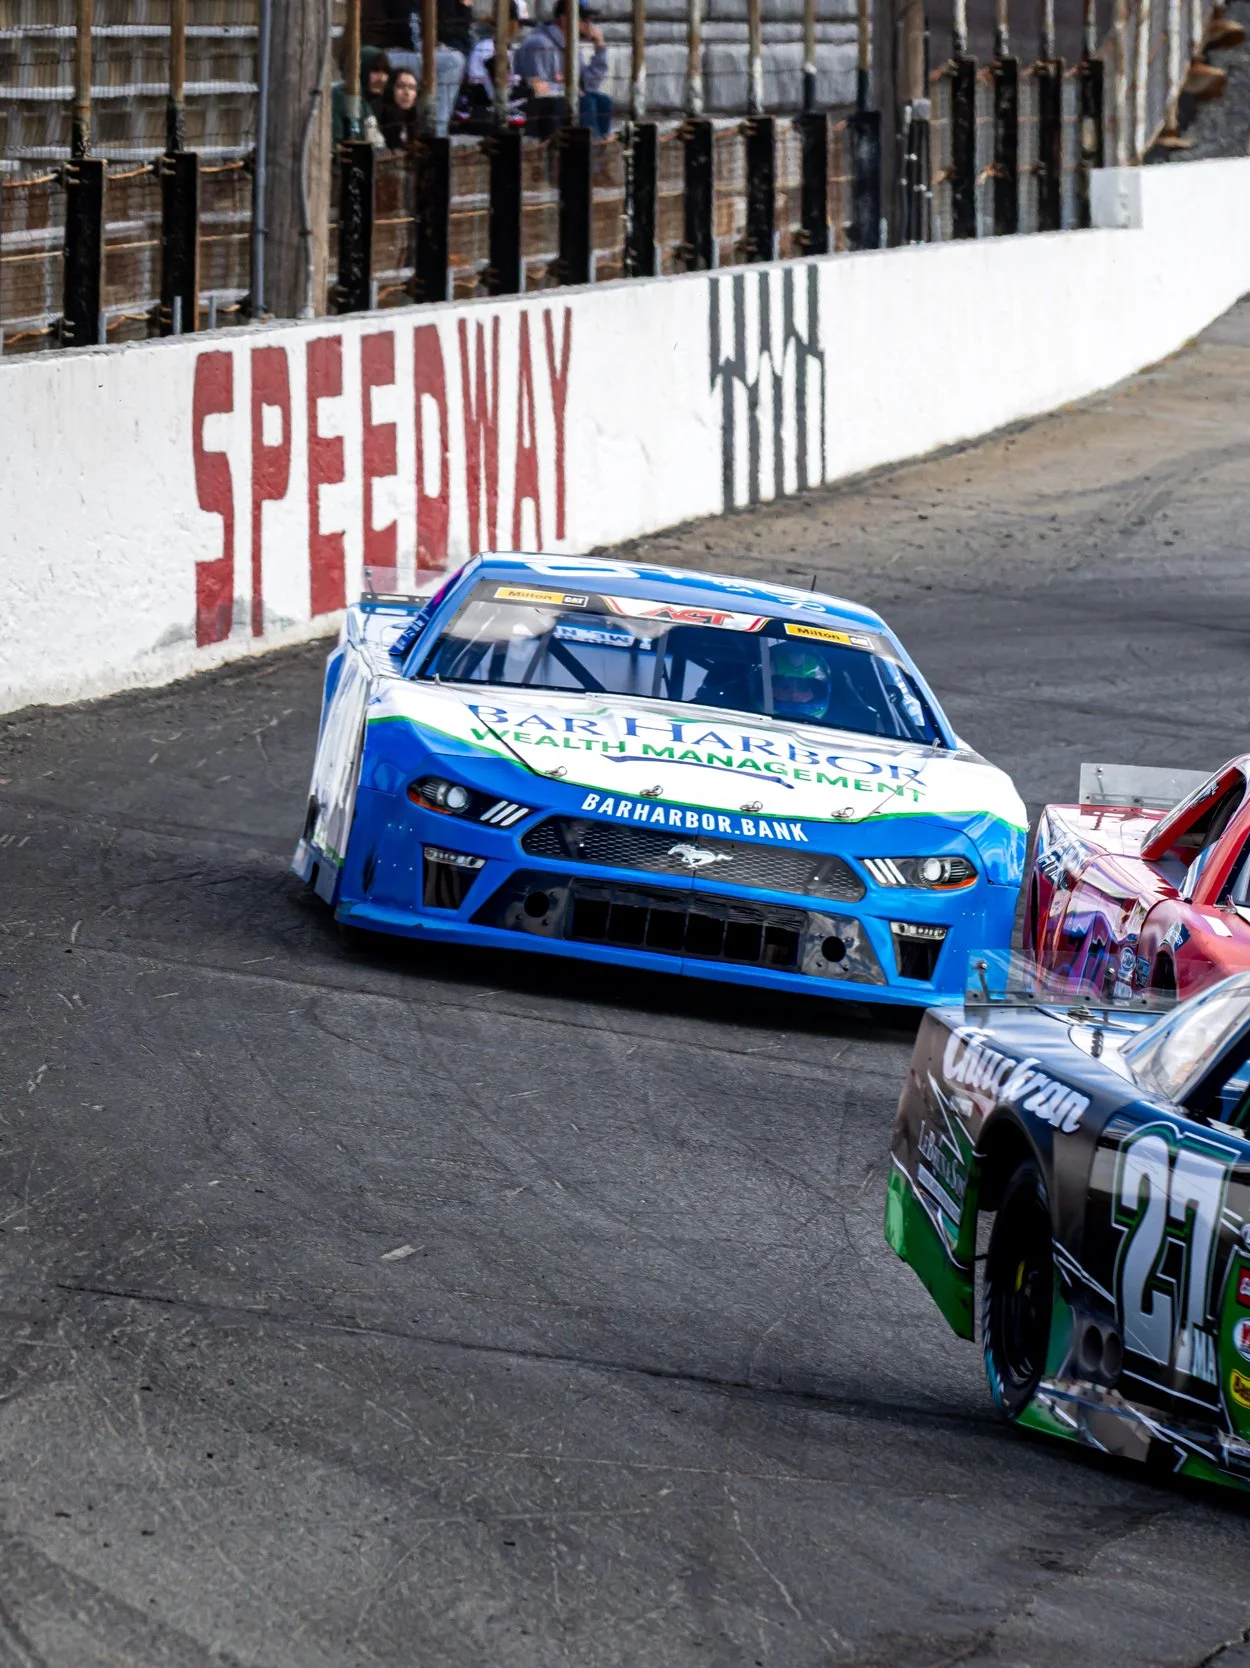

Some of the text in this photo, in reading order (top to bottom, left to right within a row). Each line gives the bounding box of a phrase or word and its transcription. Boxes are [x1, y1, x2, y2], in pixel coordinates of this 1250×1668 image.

[192, 306, 572, 648] SPEEDWAY
[508, 590, 585, 605] Milton CAT
[797, 626, 841, 641] Milton
[468, 704, 929, 787] BAR HARBOR
[469, 726, 928, 803] WEALTH MANAGEMENT
[580, 792, 809, 843] BARHARBOR.BANK
[1118, 1128, 1232, 1374] 27
